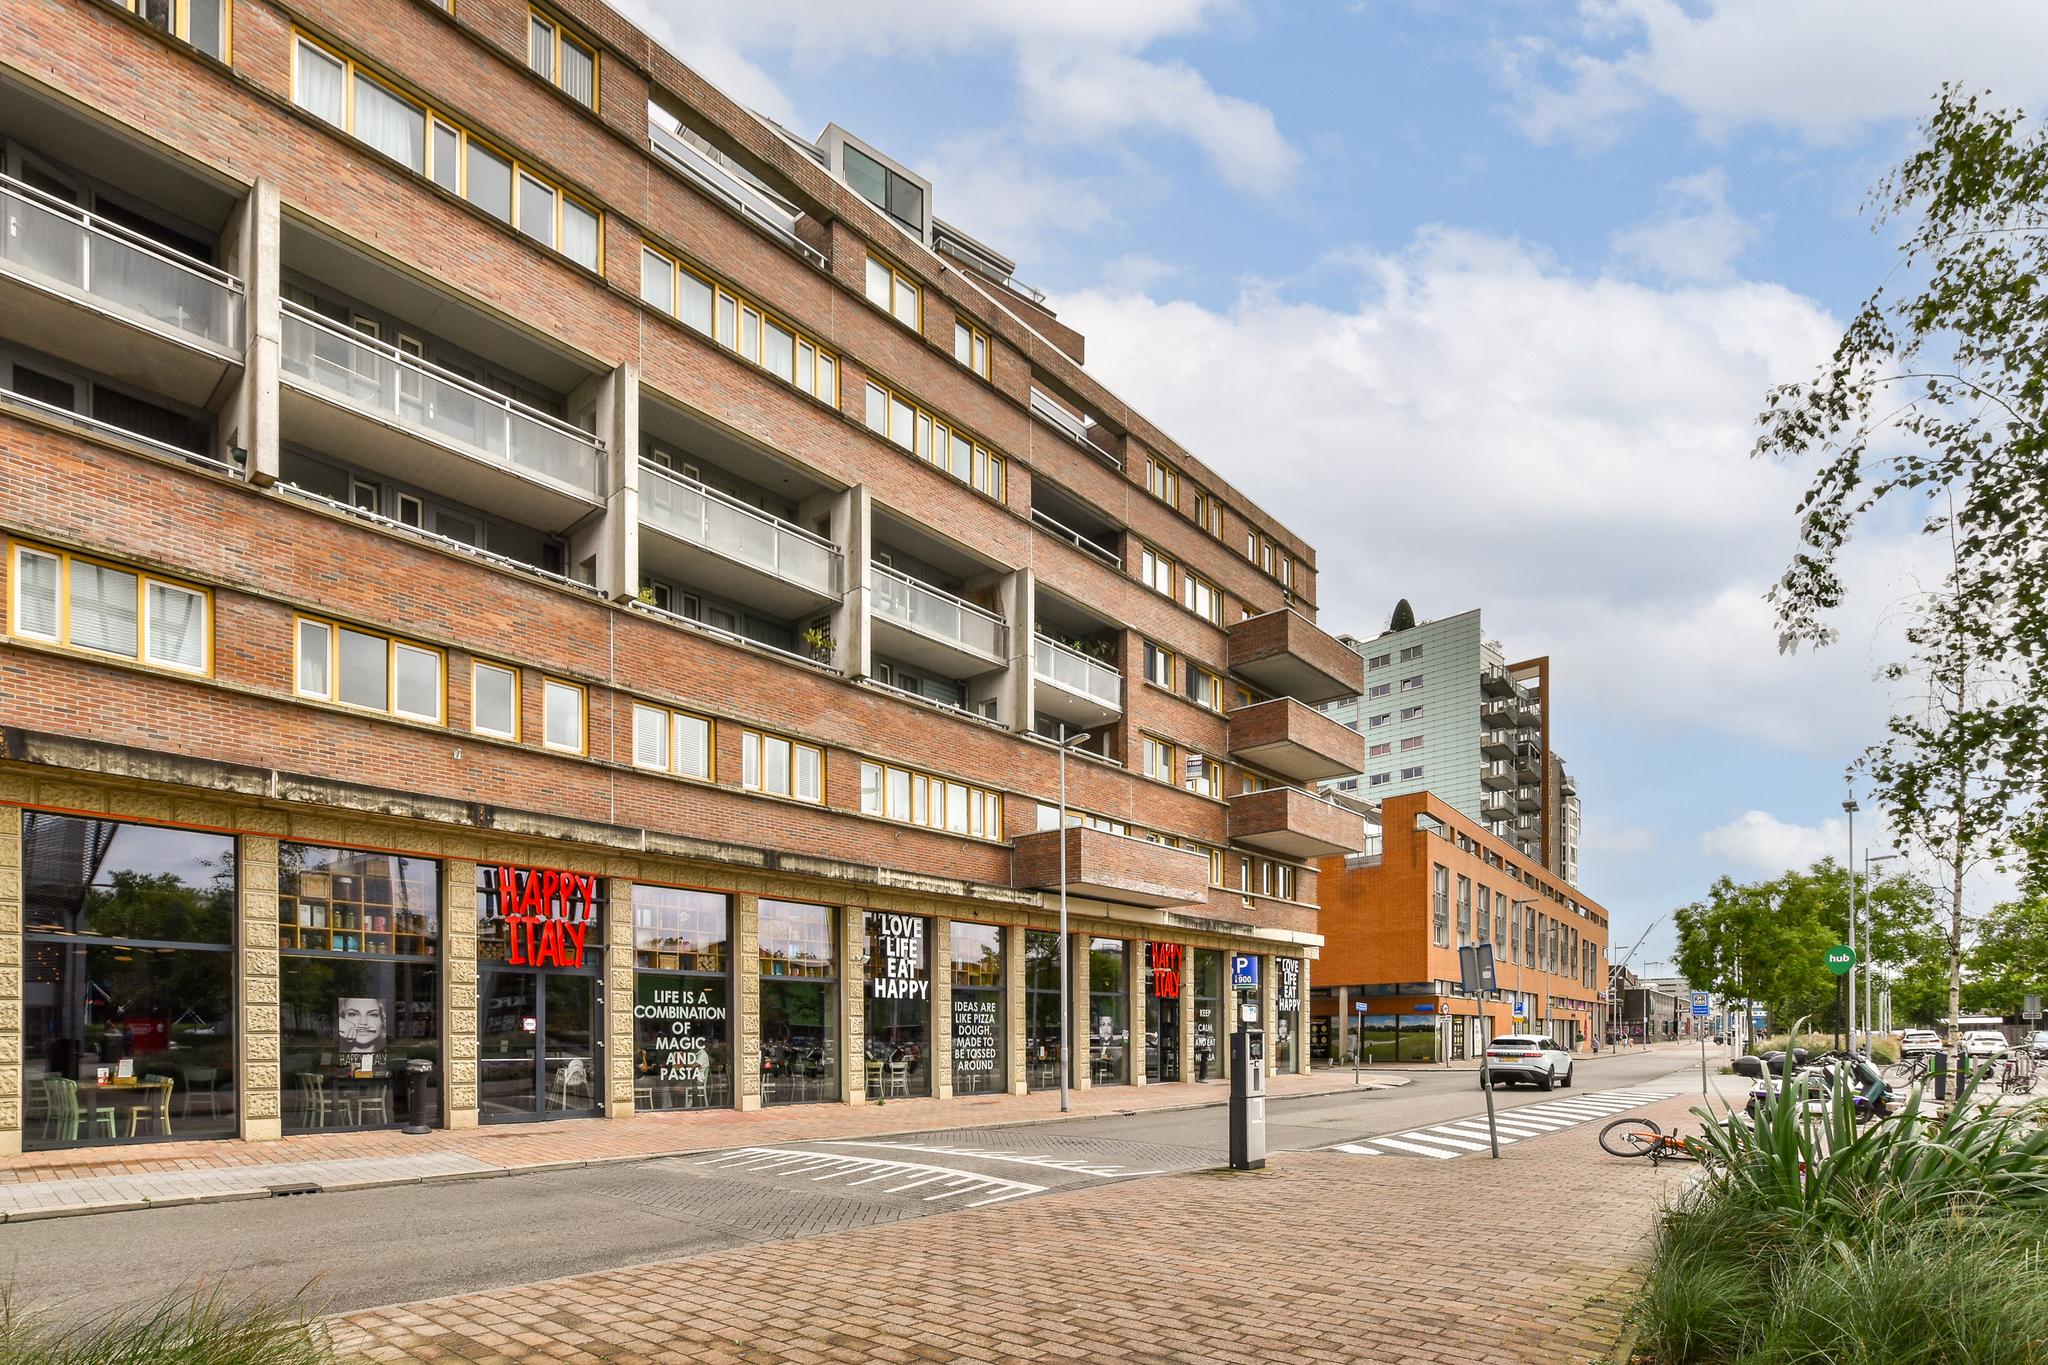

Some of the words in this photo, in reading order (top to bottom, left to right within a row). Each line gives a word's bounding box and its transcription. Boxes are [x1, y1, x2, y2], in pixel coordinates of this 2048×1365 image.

[498, 866, 595, 920] HAPPY
[881, 914, 922, 938] LOVE
[505, 916, 586, 968] ITALY
[886, 936, 917, 958] LIFE
[1152, 942, 1183, 970] HAPPY
[1829, 953, 1850, 963] hub
[887, 957, 917, 979] EAT
[1236, 957, 1249, 974] P
[1282, 958, 1299, 973] LOVE
[1154, 969, 1180, 998] ITALY
[1283, 971, 1297, 985] LIFE
[874, 977, 929, 1000] HAPPY
[1284, 985, 1297, 998] EAT
[654, 990, 679, 1004] LIFE
[683, 991, 694, 1004] IS
[697, 991, 708, 1004] A
[954, 1001, 979, 1012] IDEAS
[980, 1002, 996, 1012] ARE
[1279, 998, 1301, 1011] HAPPY
[634, 1005, 726, 1020] COMBINATION
[955, 1013, 972, 1024] LIKE
[973, 1013, 996, 1024] PIZZA
[1199, 1009, 1211, 1017] KEEP
[672, 1021, 691, 1035] OF
[958, 1025, 992, 1036] DOUGH,
[655, 1036, 706, 1050] MAGIC
[956, 1037, 982, 1047] MADE
[983, 1037, 994, 1047] TO
[1194, 1037, 1207, 1047] AND
[1206, 1038, 1216, 1046] EAT
[665, 1052, 697, 1065] AND
[954, 1048, 965, 1059] BE
[966, 1048, 996, 1059] TOSSED
[957, 1060, 994, 1071] AROUND
[660, 1067, 702, 1081] PASTA
